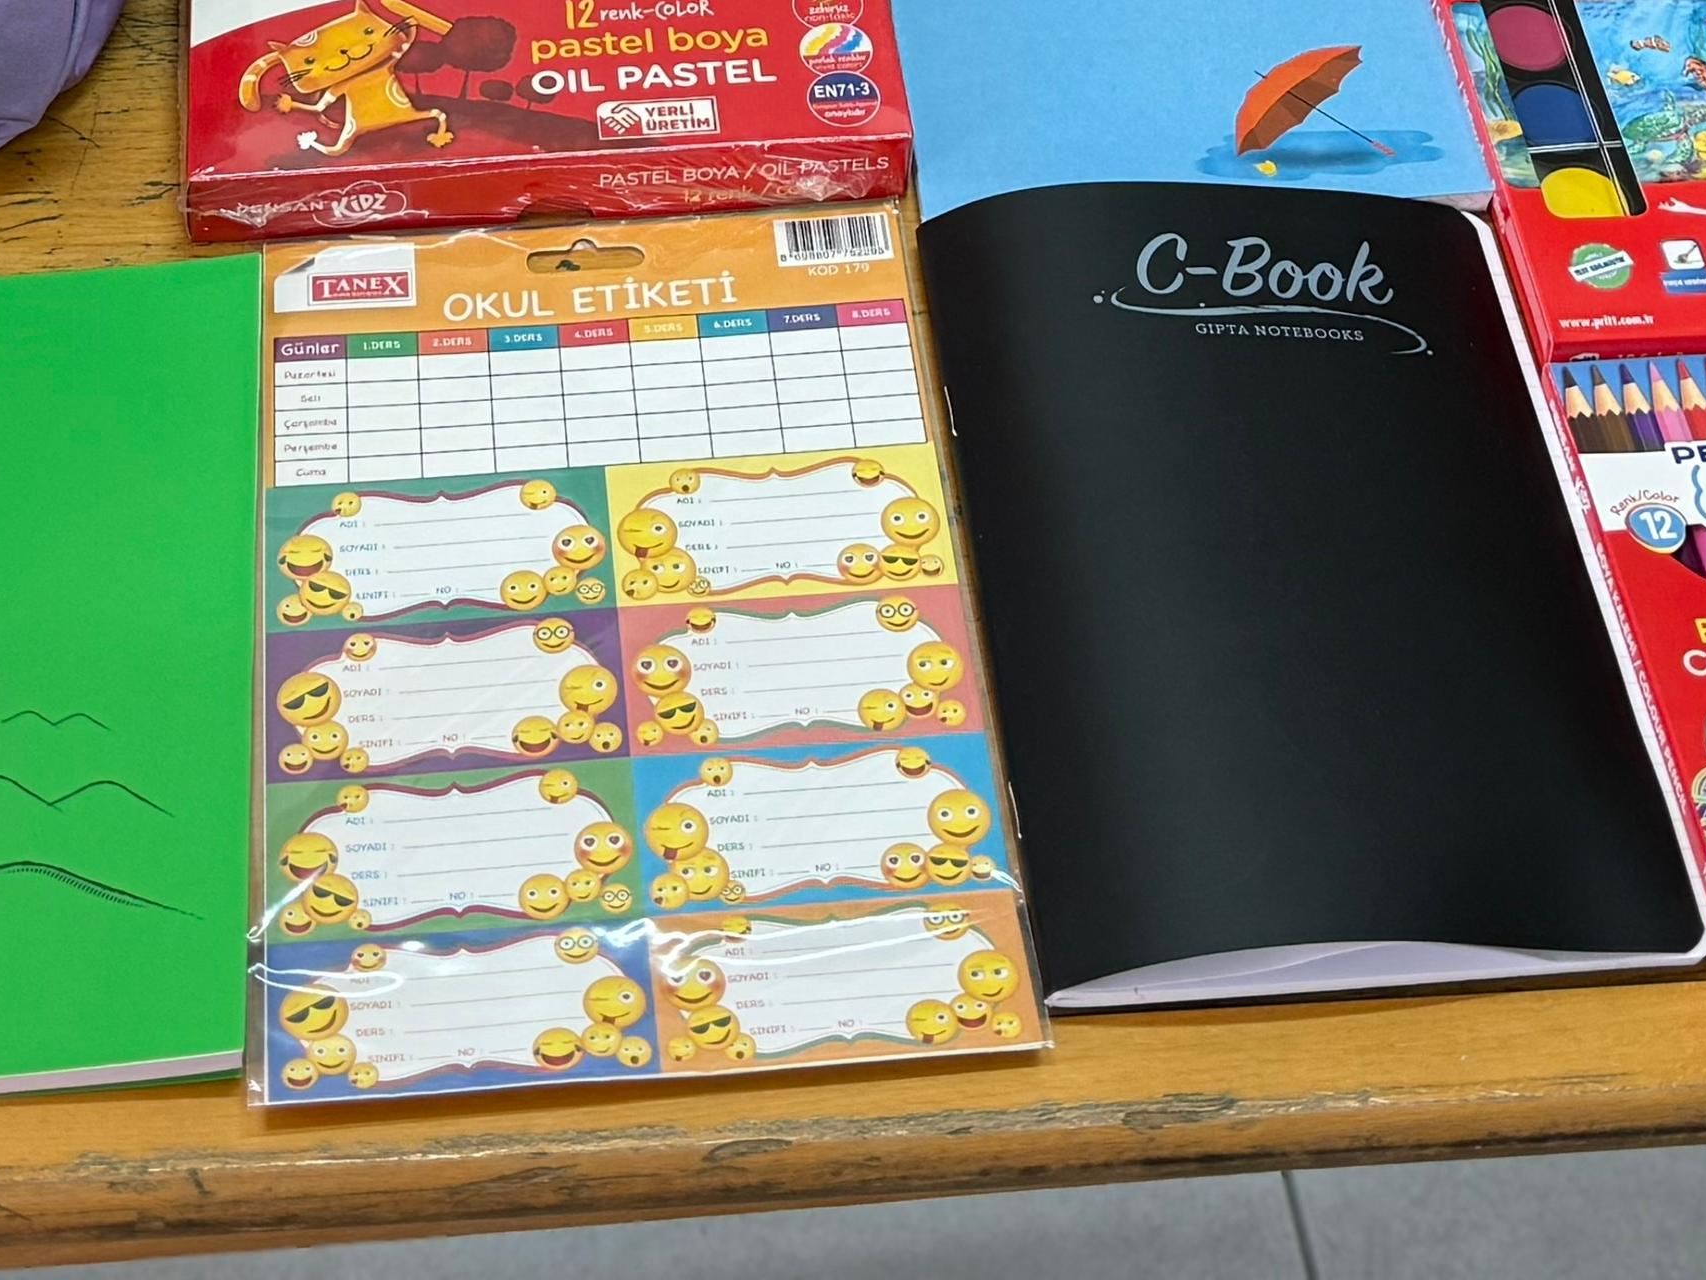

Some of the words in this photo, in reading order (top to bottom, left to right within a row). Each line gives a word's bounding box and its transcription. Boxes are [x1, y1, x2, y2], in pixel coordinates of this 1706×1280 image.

[531, 28, 654, 65] pastel
[668, 26, 769, 54] boya
[531, 68, 605, 96] OIL
[617, 58, 778, 91] PASTEL
[814, 82, 870, 98] EN71-3
[645, 103, 695, 118] YERLİ
[646, 116, 711, 132] ÜRETİM
[599, 171, 677, 188] PASTEL
[683, 166, 739, 183] BOYA
[760, 162, 794, 178] OIL
[800, 156, 889, 174] PASTELS
[808, 265, 839, 277] KOD
[1136, 233, 1393, 305] C-Book
[316, 275, 408, 298] TANEX
[443, 288, 554, 322] OKUL
[572, 270, 738, 316] ETİKETİ
[1559, 314, 1654, 330] www.pritt.com.tr
[1195, 322, 1250, 336] GIPTA
[1255, 324, 1365, 341] NOTEBOOKS
[281, 341, 340, 357] Günler
[1640, 511, 1678, 539] 12
[815, 863, 832, 872] NO
[448, 891, 466, 901] NO
